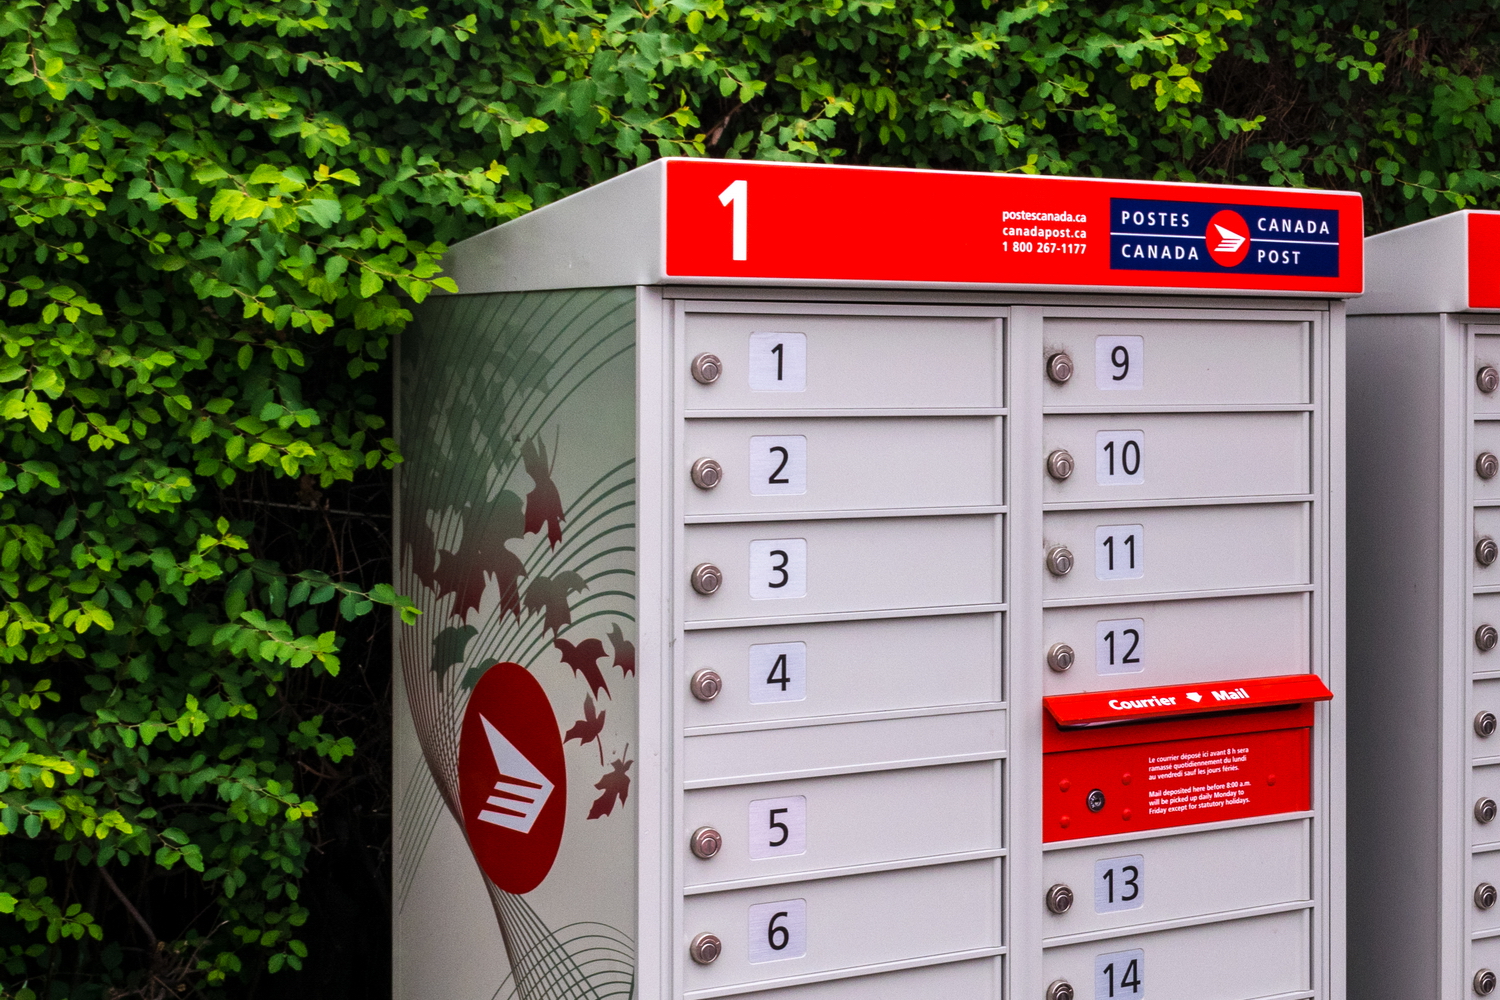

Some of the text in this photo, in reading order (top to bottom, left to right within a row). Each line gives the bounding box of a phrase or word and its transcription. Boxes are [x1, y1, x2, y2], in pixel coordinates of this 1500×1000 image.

[718, 180, 748, 261] 1
[1002, 210, 1087, 223] postescanada.ca
[1002, 225, 1087, 240] canadapost.ca
[1122, 211, 1330, 234] POSTES CANADA
[1012, 241, 1033, 253] 800
[1037, 242, 1087, 254] 267-1177
[1122, 244, 1300, 264] CANADA POST
[771, 343, 784, 381] 1
[1111, 345, 1129, 381] 9
[768, 446, 789, 484] 2
[1103, 440, 1141, 476] 10
[768, 549, 789, 589] 3
[1103, 534, 1135, 571] 11
[1103, 628, 1140, 665] 12
[766, 654, 791, 691] 4
[1108, 688, 1250, 710] Courrier Mail
[1157, 771, 1183, 779] vendredi
[1173, 759, 1222, 770] quotidiennement
[1163, 787, 1191, 796] deposited
[1170, 795, 1188, 805] picked
[1214, 790, 1237, 798] Monday
[769, 807, 789, 847] 5
[1103, 865, 1139, 903] 13
[768, 911, 789, 951] 6
[1103, 959, 1141, 998] 14
